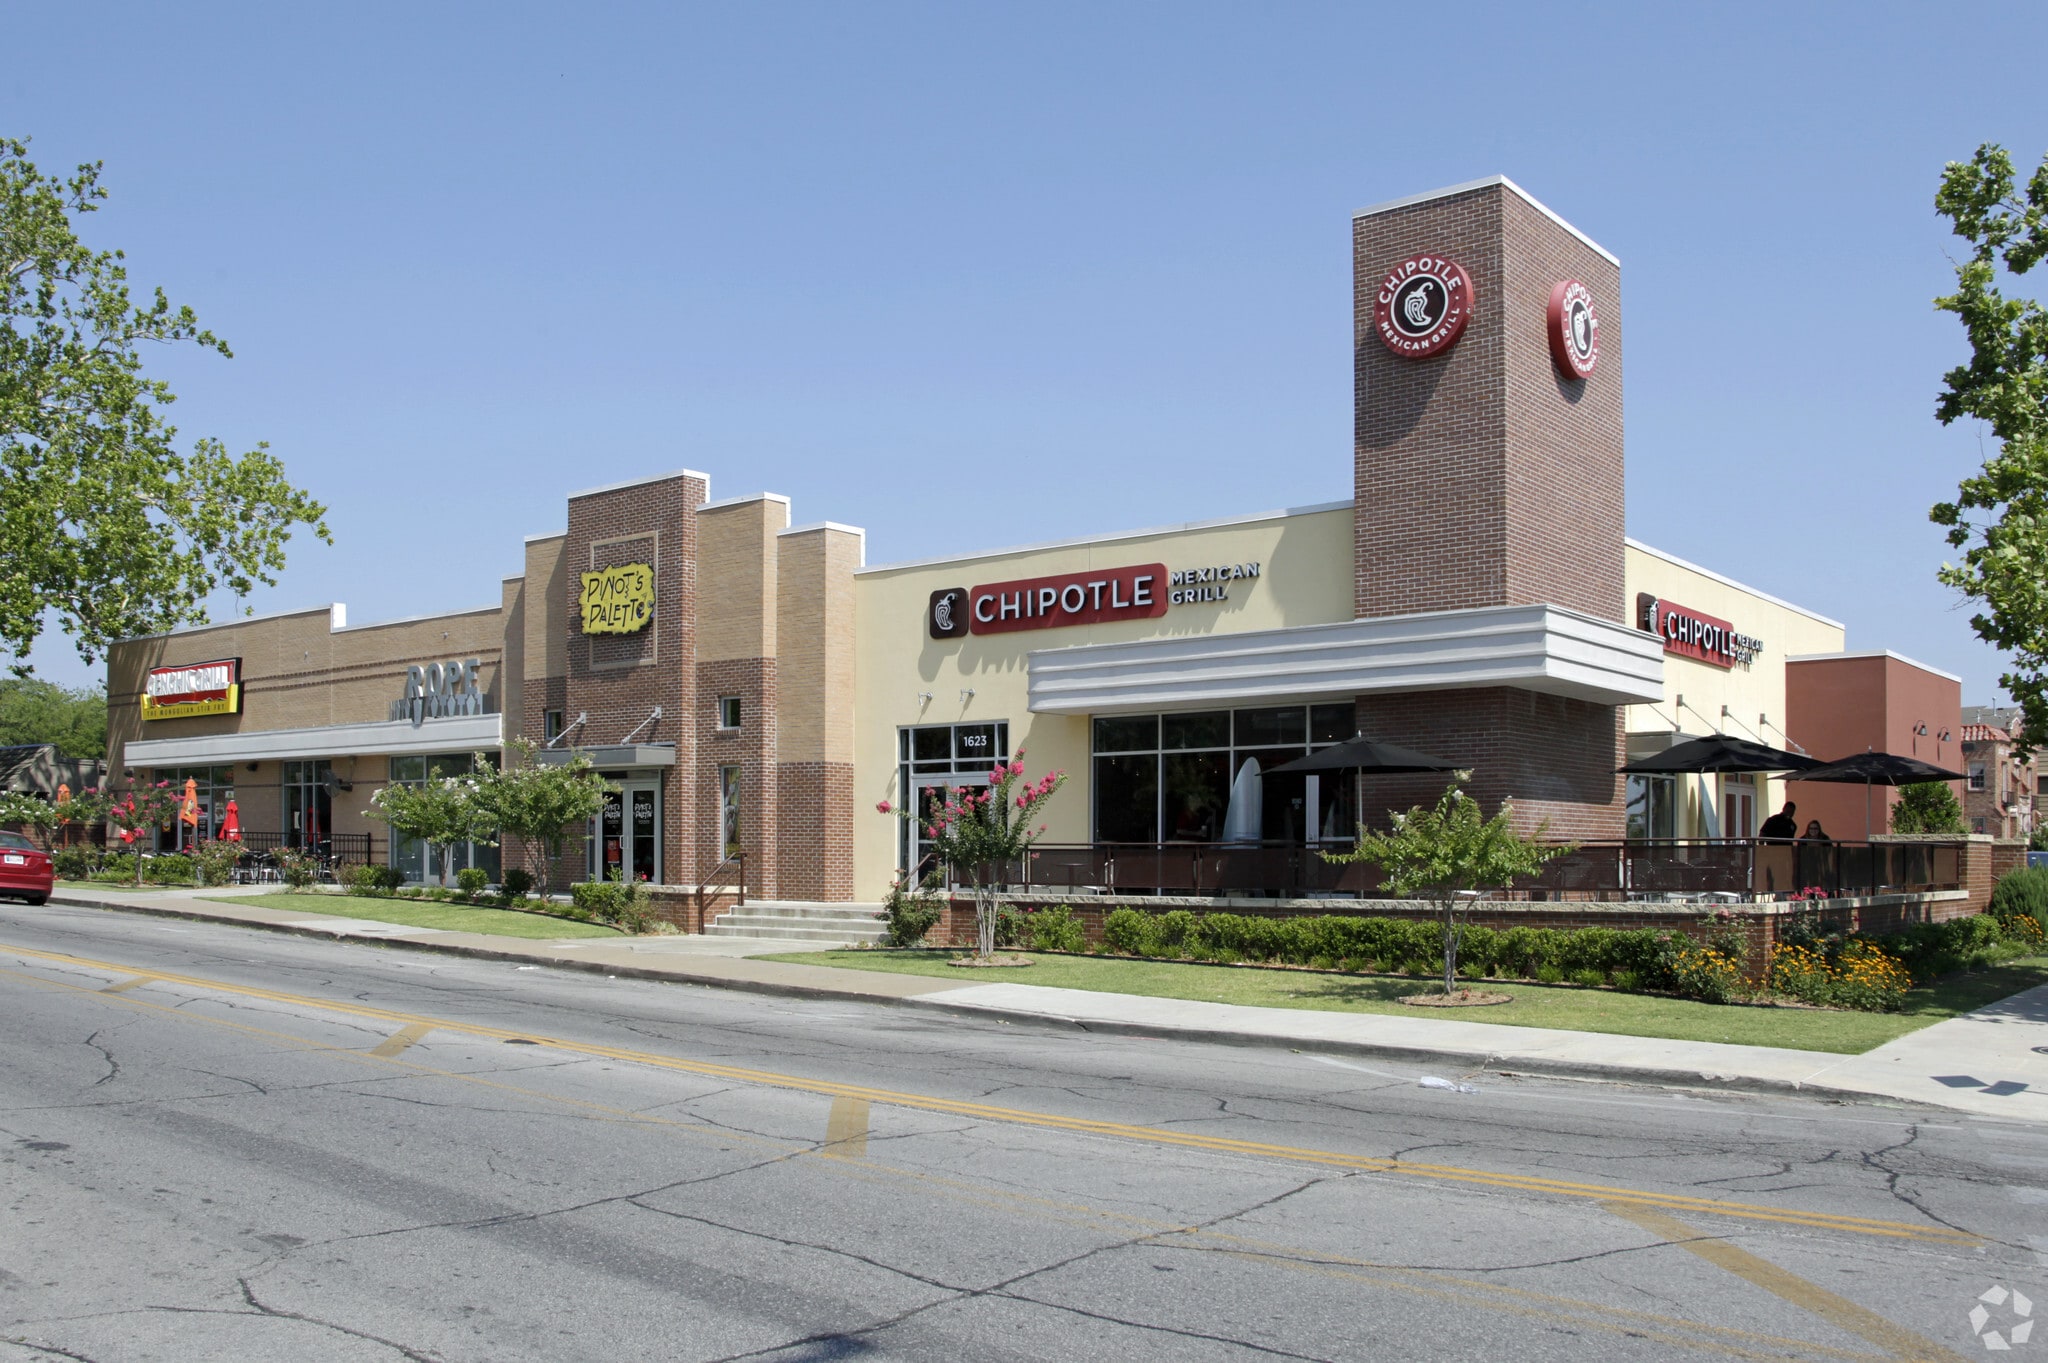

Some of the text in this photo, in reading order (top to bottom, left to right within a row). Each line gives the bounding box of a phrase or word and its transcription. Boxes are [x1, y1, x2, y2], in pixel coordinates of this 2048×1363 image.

[1379, 257, 1462, 304] CHIPOTLE
[1381, 307, 1460, 350] MEXICAN GRILL
[587, 570, 644, 603] PINOT'S
[1171, 562, 1260, 587] MEXICAN
[975, 575, 1154, 623] CHIPOTLE
[1171, 586, 1228, 605] GRILL
[1666, 611, 1737, 658] CHIPOTLE
[1736, 634, 1764, 652] MEXICAN
[194, 665, 231, 692] GRILL
[963, 735, 987, 747] 1623
